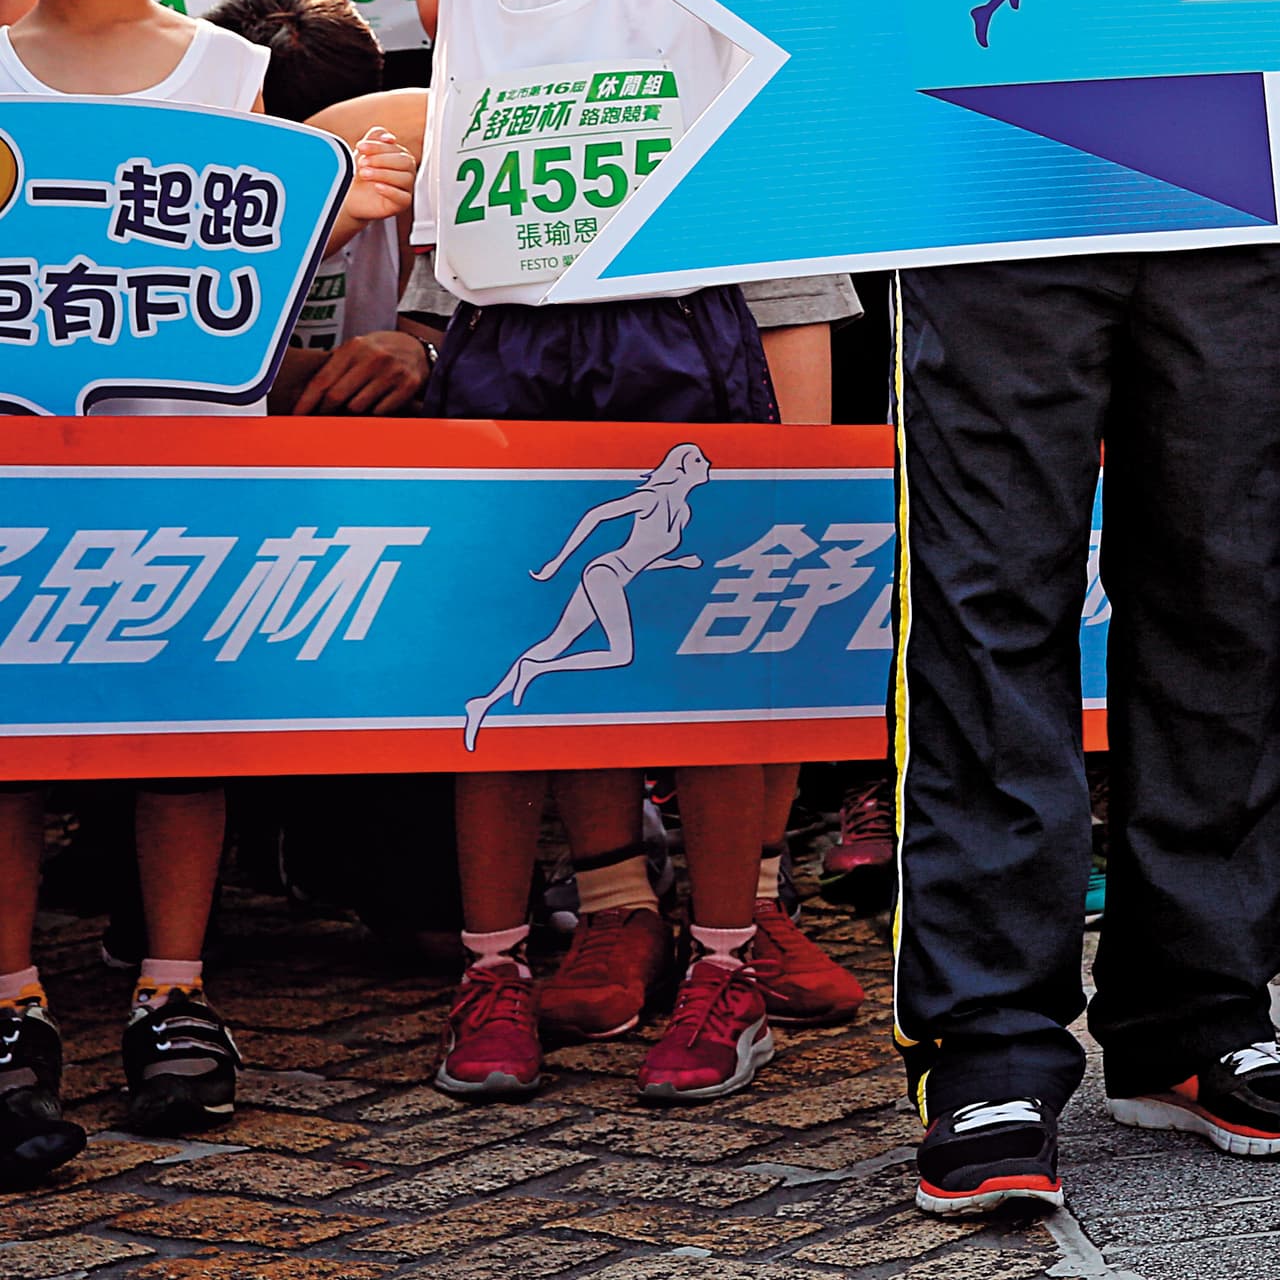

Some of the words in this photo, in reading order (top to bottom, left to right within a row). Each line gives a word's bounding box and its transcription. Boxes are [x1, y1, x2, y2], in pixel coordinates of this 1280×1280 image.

[597, 74, 663, 98] 休閒組
[483, 99, 577, 141] 舒跑杯
[578, 104, 662, 127] 路跑競賽
[31, 164, 279, 248] 一起跑
[517, 217, 598, 251] 張瑜恩
[520, 257, 559, 272] FESTO
[0, 524, 430, 665] 跑杯
